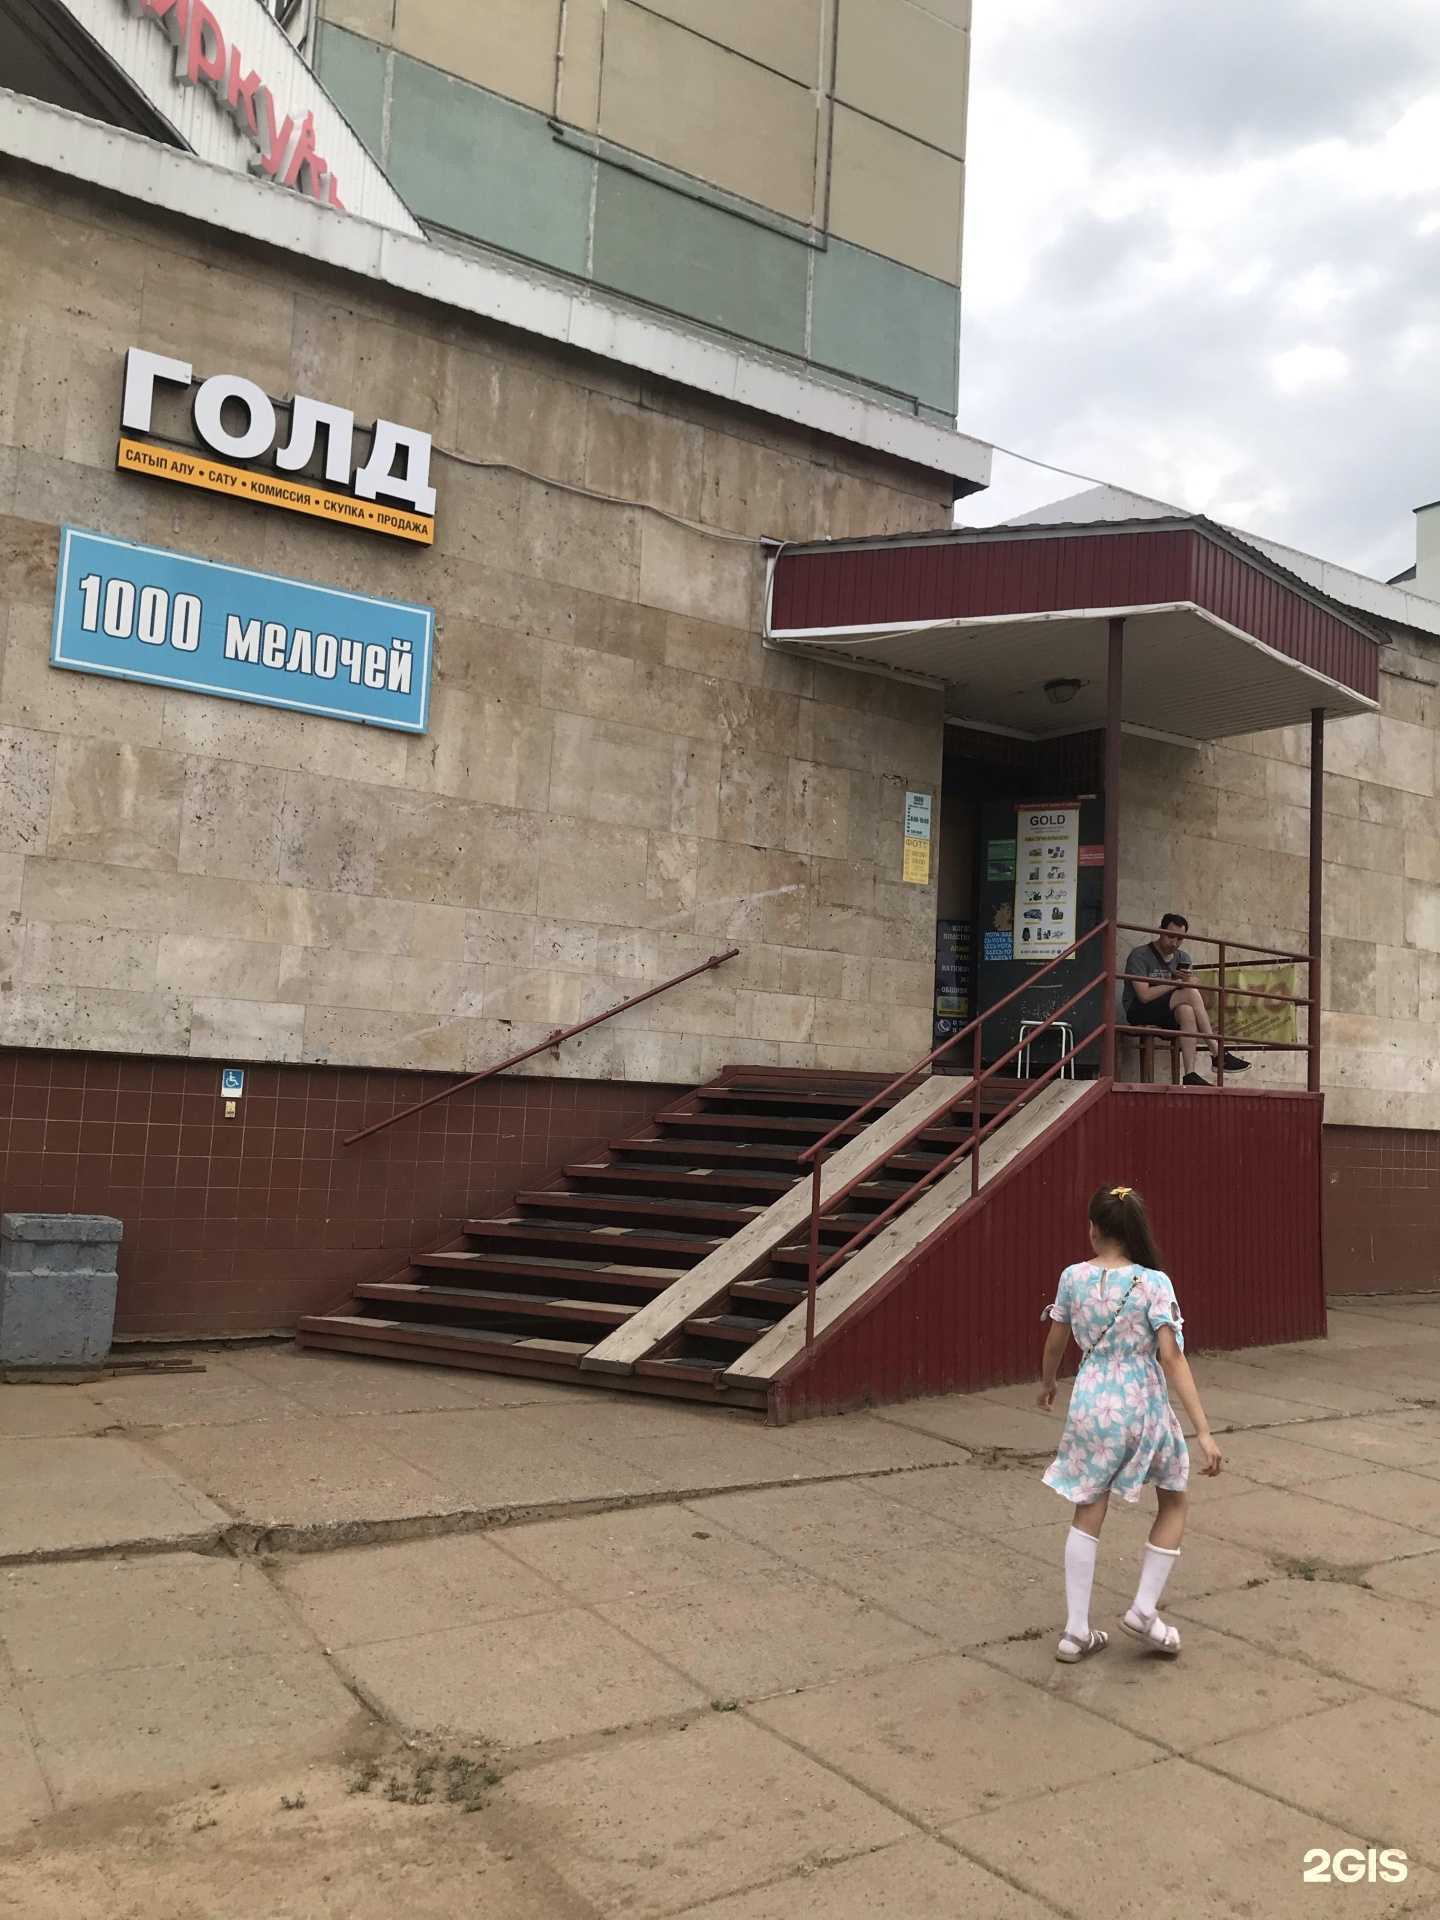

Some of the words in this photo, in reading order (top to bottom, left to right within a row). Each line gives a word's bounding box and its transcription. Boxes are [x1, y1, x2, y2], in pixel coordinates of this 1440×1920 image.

[121, 347, 437, 515] ГОЛД
[125, 448, 169, 471] САТЫП
[170, 460, 196, 478] АЛУ
[208, 470, 239, 487] САТУ
[250, 482, 312, 506] КОМИССИЯ
[323, 500, 366, 520] СКУПКА
[377, 513, 430, 537] ПРОДАЖА
[79, 574, 203, 653] 1000
[223, 615, 414, 695] мелочей
[1030, 814, 1066, 826] GOLD
